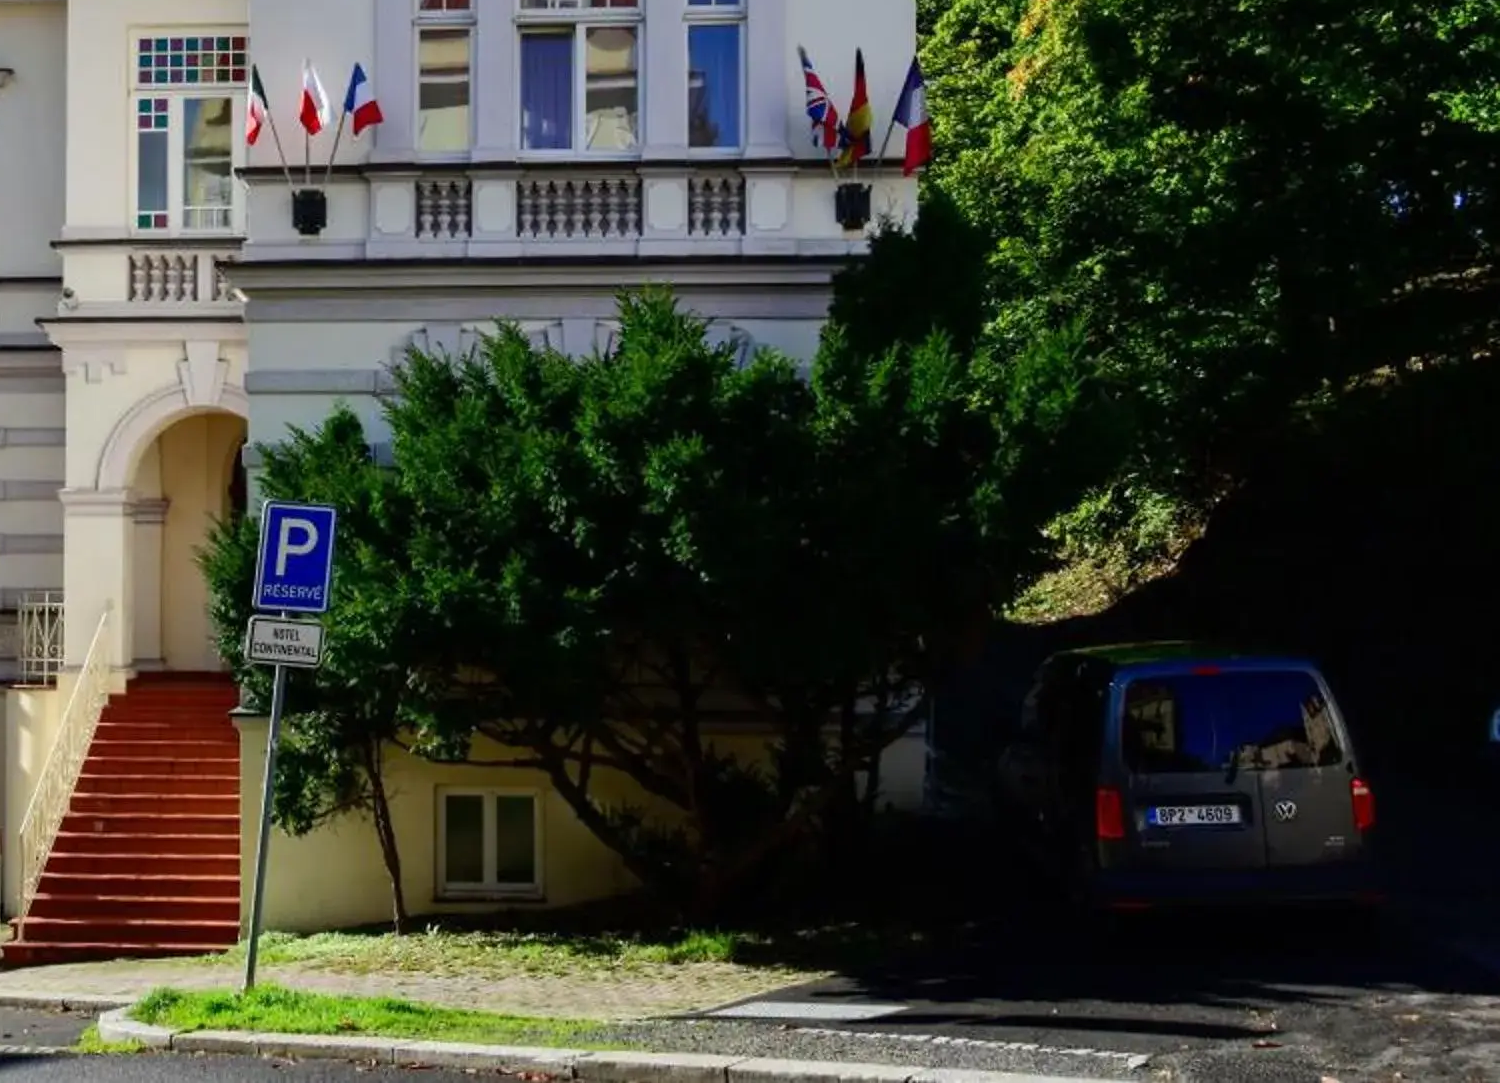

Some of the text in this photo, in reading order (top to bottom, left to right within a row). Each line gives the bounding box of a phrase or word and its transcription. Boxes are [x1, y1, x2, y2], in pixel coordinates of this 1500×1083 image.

[275, 517, 319, 576] P
[273, 628, 300, 641] HOTEL
[253, 642, 317, 658] CONTINENTAL
